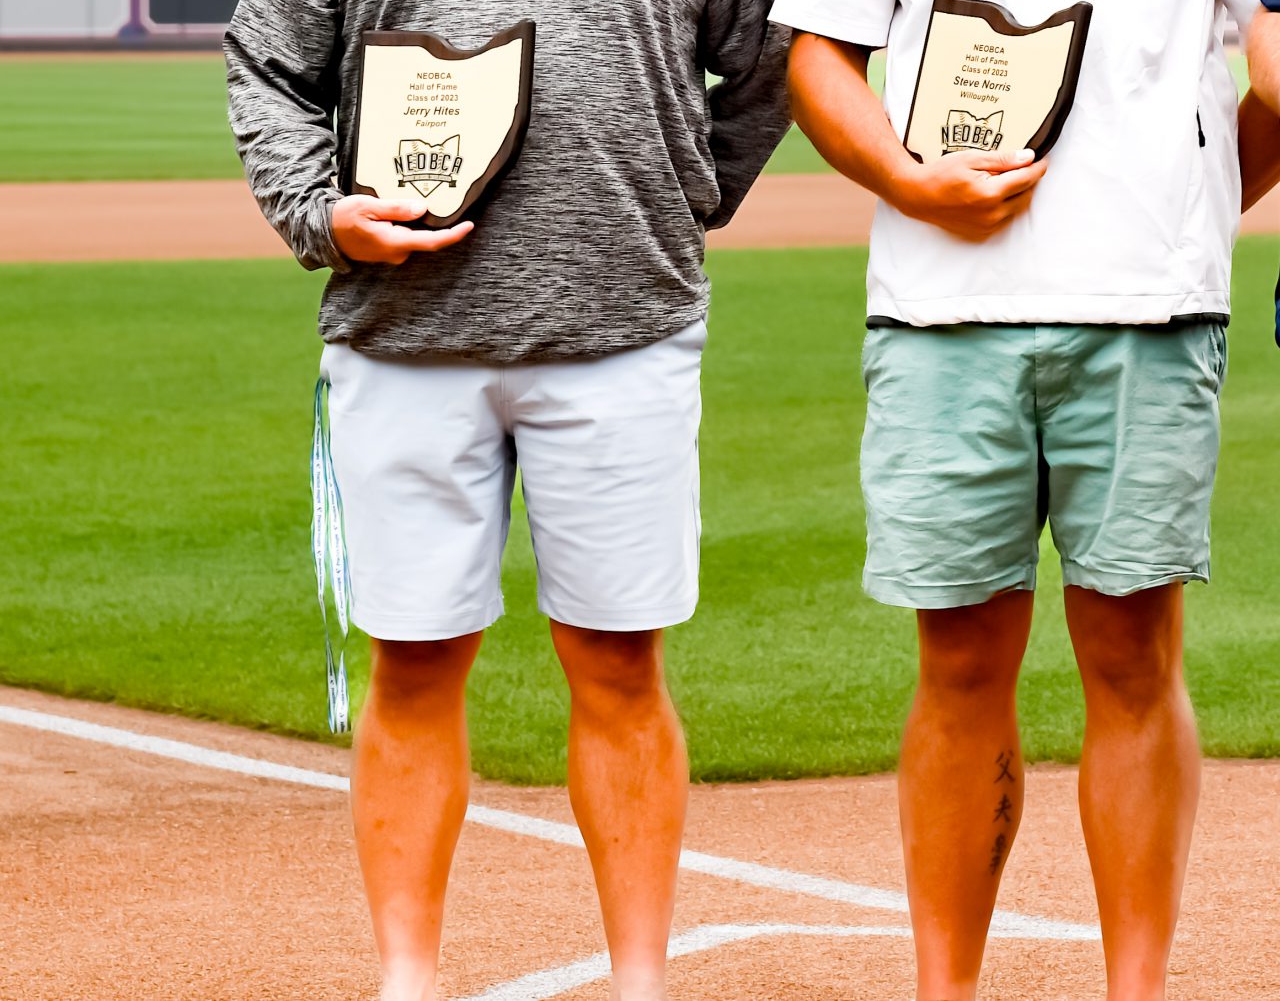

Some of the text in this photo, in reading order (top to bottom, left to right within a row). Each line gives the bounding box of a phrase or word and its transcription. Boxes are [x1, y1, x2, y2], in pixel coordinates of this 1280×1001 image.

[973, 44, 1005, 54] NEOBCA
[965, 54, 1009, 66] Hall of Fame
[416, 72, 452, 80] NEOBCA
[961, 65, 1008, 77] Class of 2023
[409, 83, 458, 91] Hall of Fame
[953, 76, 1011, 92] Steve Norris
[406, 94, 459, 102] Class of 2023
[960, 90, 1000, 103] Willoughby
[403, 106, 460, 118] Jerry Hites
[415, 120, 447, 128] Fairport
[941, 124, 1004, 150] NEOBCA
[394, 152, 464, 174] NEOBCA
